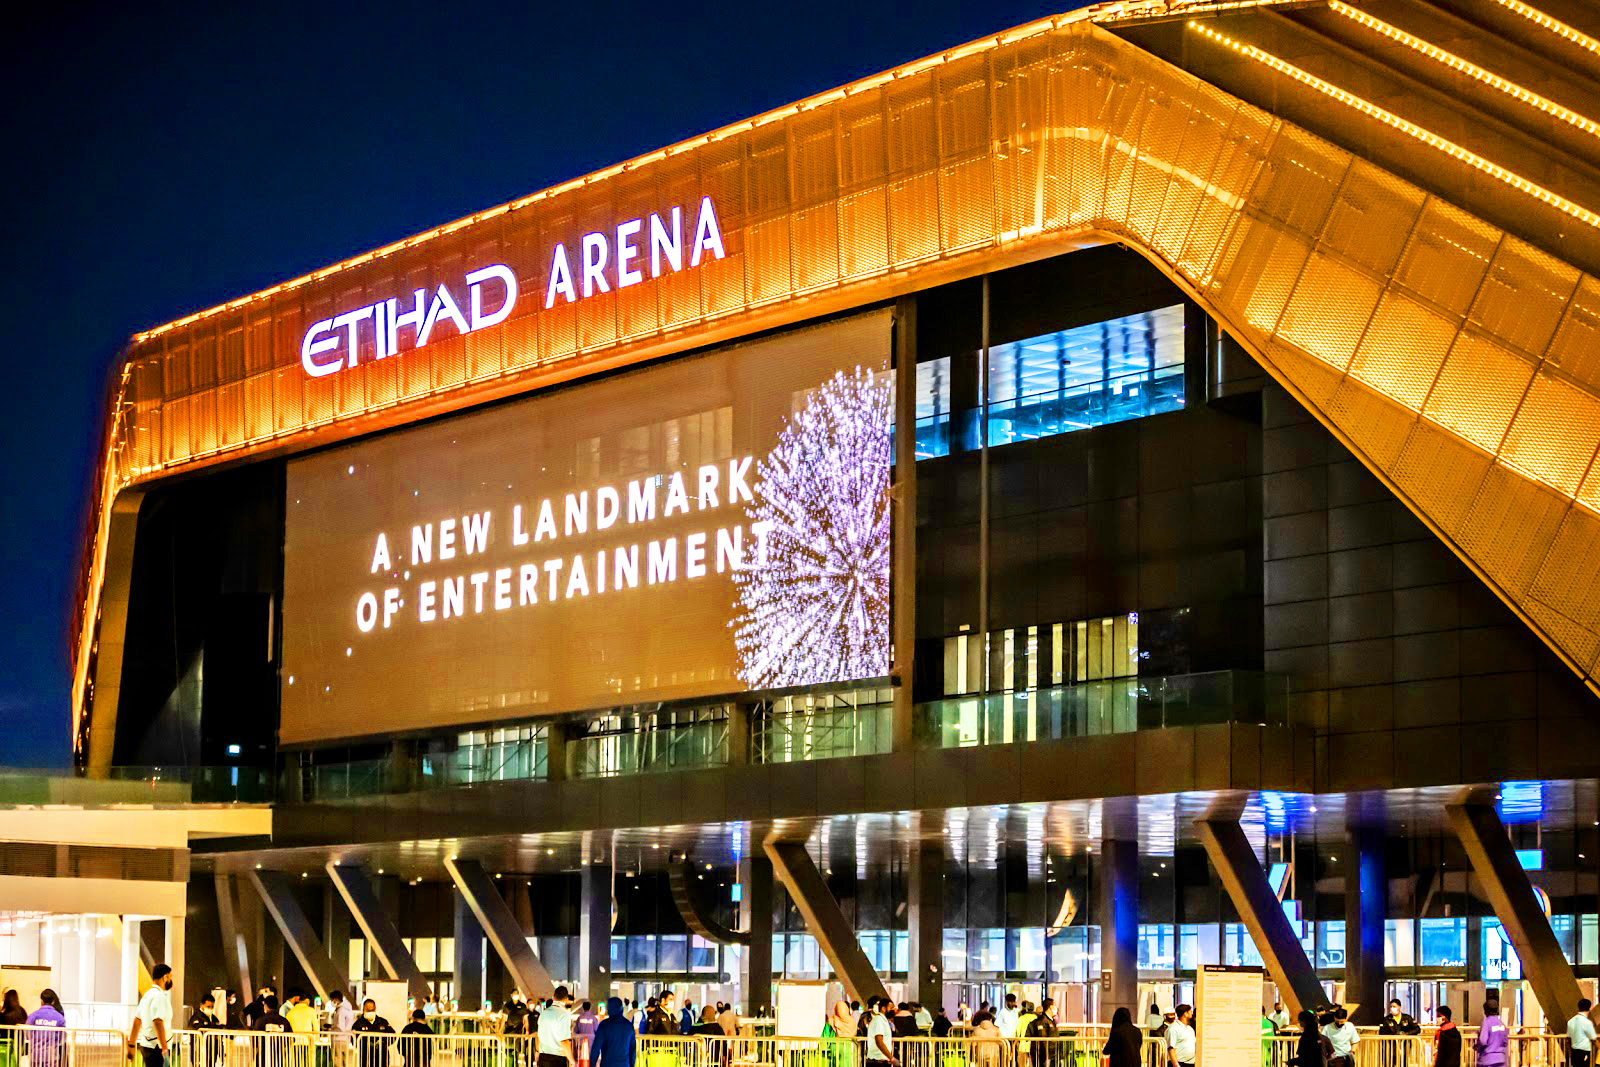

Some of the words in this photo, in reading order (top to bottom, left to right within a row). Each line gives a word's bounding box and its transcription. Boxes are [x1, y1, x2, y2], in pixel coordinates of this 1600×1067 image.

[301, 264, 518, 378] ETIHAD
[545, 196, 726, 310] ARENA
[355, 587, 401, 634] OF
[418, 518, 774, 623] ENTERTAINMENT
[370, 532, 397, 577] A
[410, 510, 492, 566] NEW
[511, 455, 754, 547] LANDMARK
